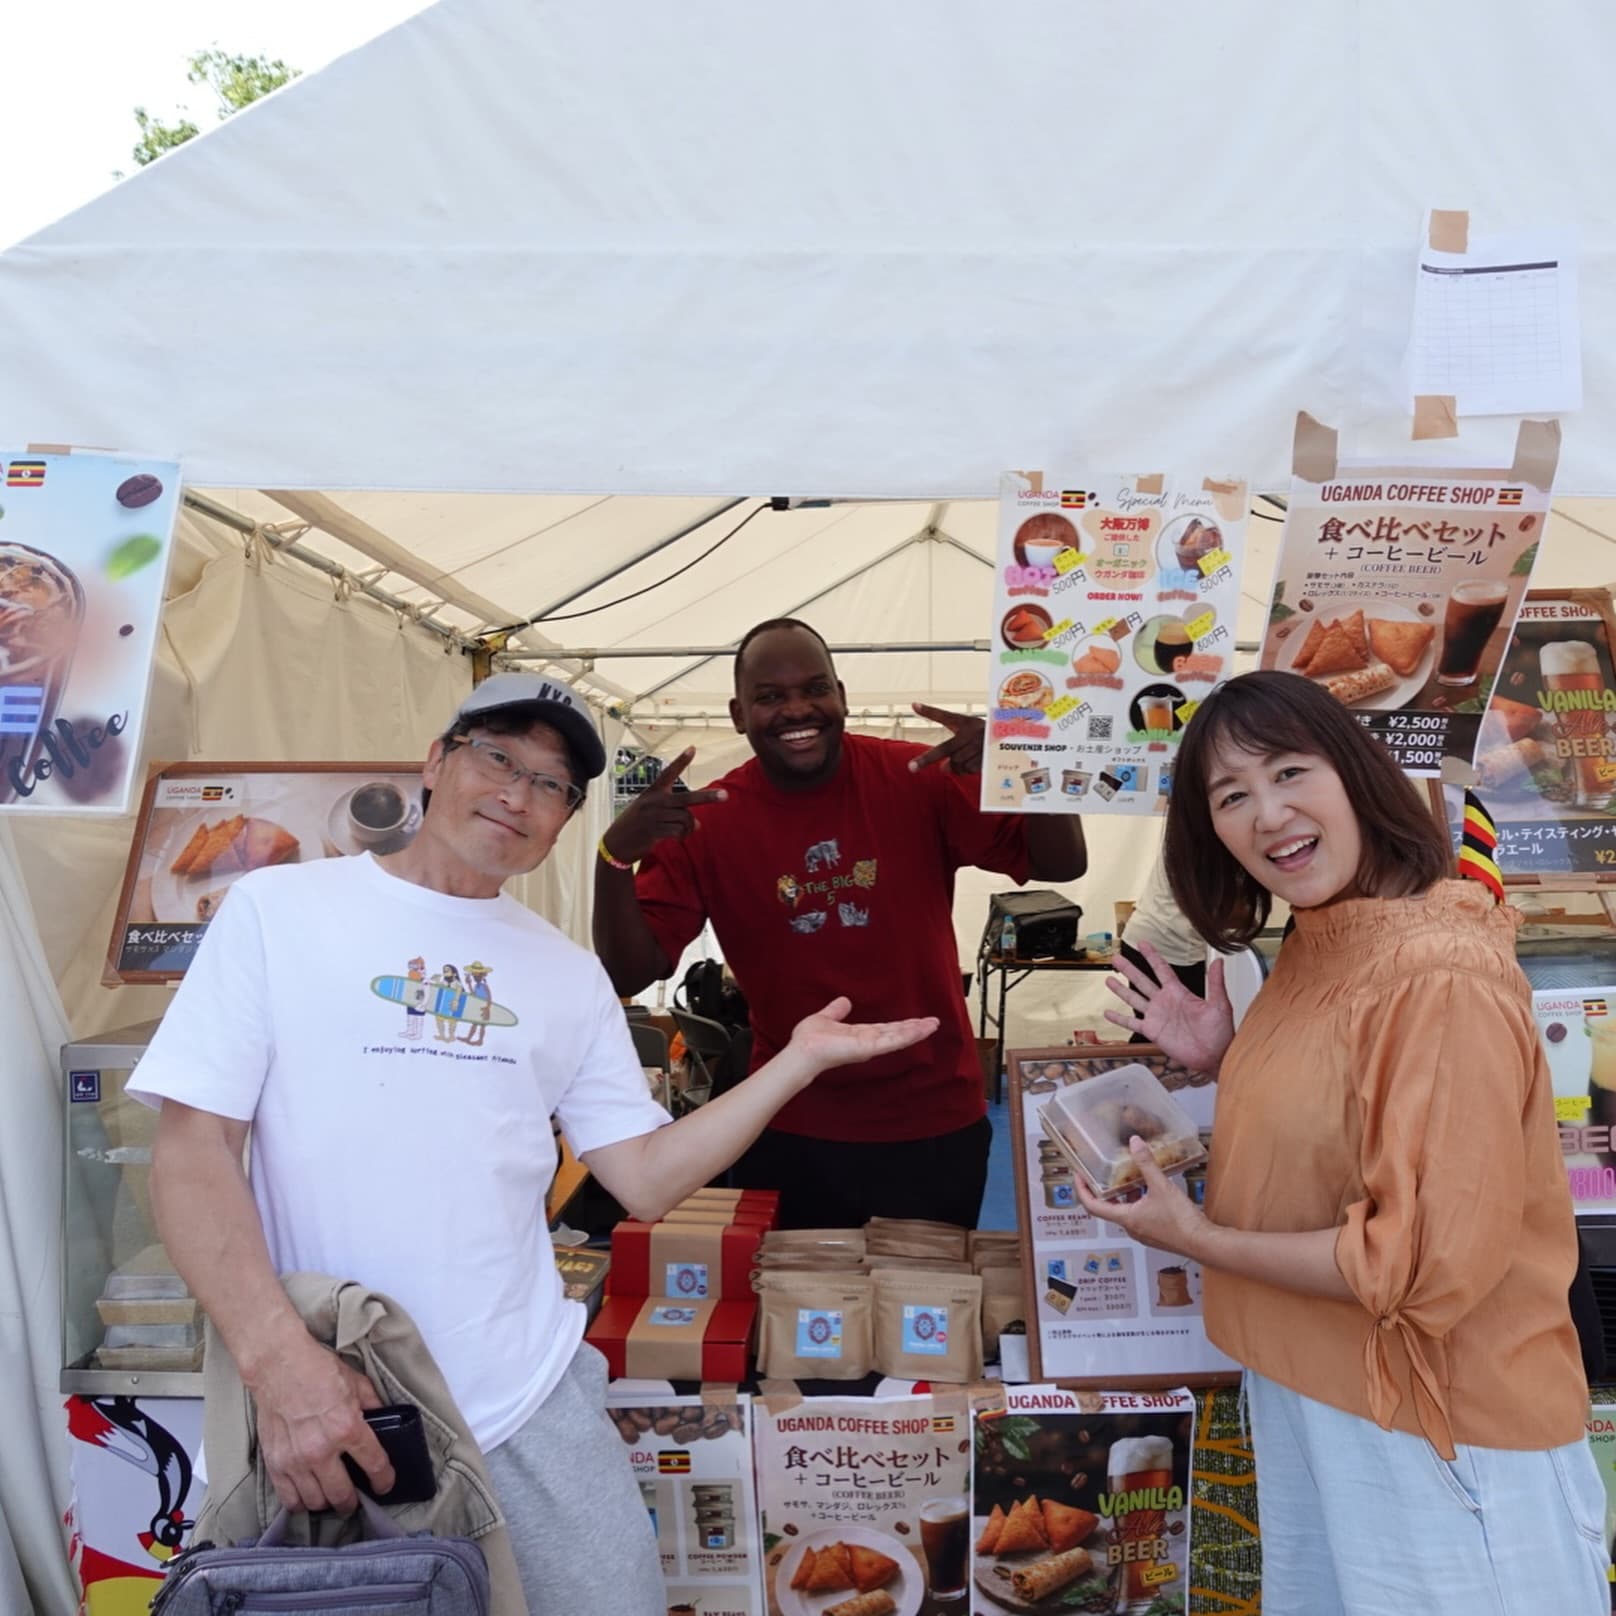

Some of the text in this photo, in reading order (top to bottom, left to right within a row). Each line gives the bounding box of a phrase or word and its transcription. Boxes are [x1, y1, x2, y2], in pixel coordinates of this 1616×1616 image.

[1018, 490, 1060, 499] UGANDA
[1116, 488, 1213, 511] Special Menu
[1321, 484, 1495, 504] UGANDA COFFEE SHOP
[1100, 517, 1150, 531] 大阪万博
[1318, 516, 1506, 548] 食べ比べセット
[1346, 545, 1488, 565] コーヒービール
[1537, 688, 1616, 713] VANILLA
[1388, 716, 1440, 729] ¥2,500
[1000, 743, 1067, 752] SOUVENIR SHOP
[1385, 733, 1436, 746] ¥2,000
[1556, 738, 1616, 758] BEER
[8, 709, 128, 797] Coffee
[1389, 751, 1434, 765] 1,500
[804, 874, 854, 894] THE BIG
[826, 891, 836, 905] 5
[1536, 1001, 1581, 1011] UGANDA
[1099, 1276, 1127, 1284] COFFEE
[1008, 1395, 1076, 1409] UGANDA
[1143, 1394, 1185, 1408] SHOP
[777, 1416, 929, 1435] UGANDA COFFEE SHOP
[784, 1445, 950, 1470] 食べ比べセット
[815, 1471, 941, 1489] コーヒービール
[1098, 1485, 1184, 1518] VANILLA
[1108, 1538, 1169, 1566] BEER
